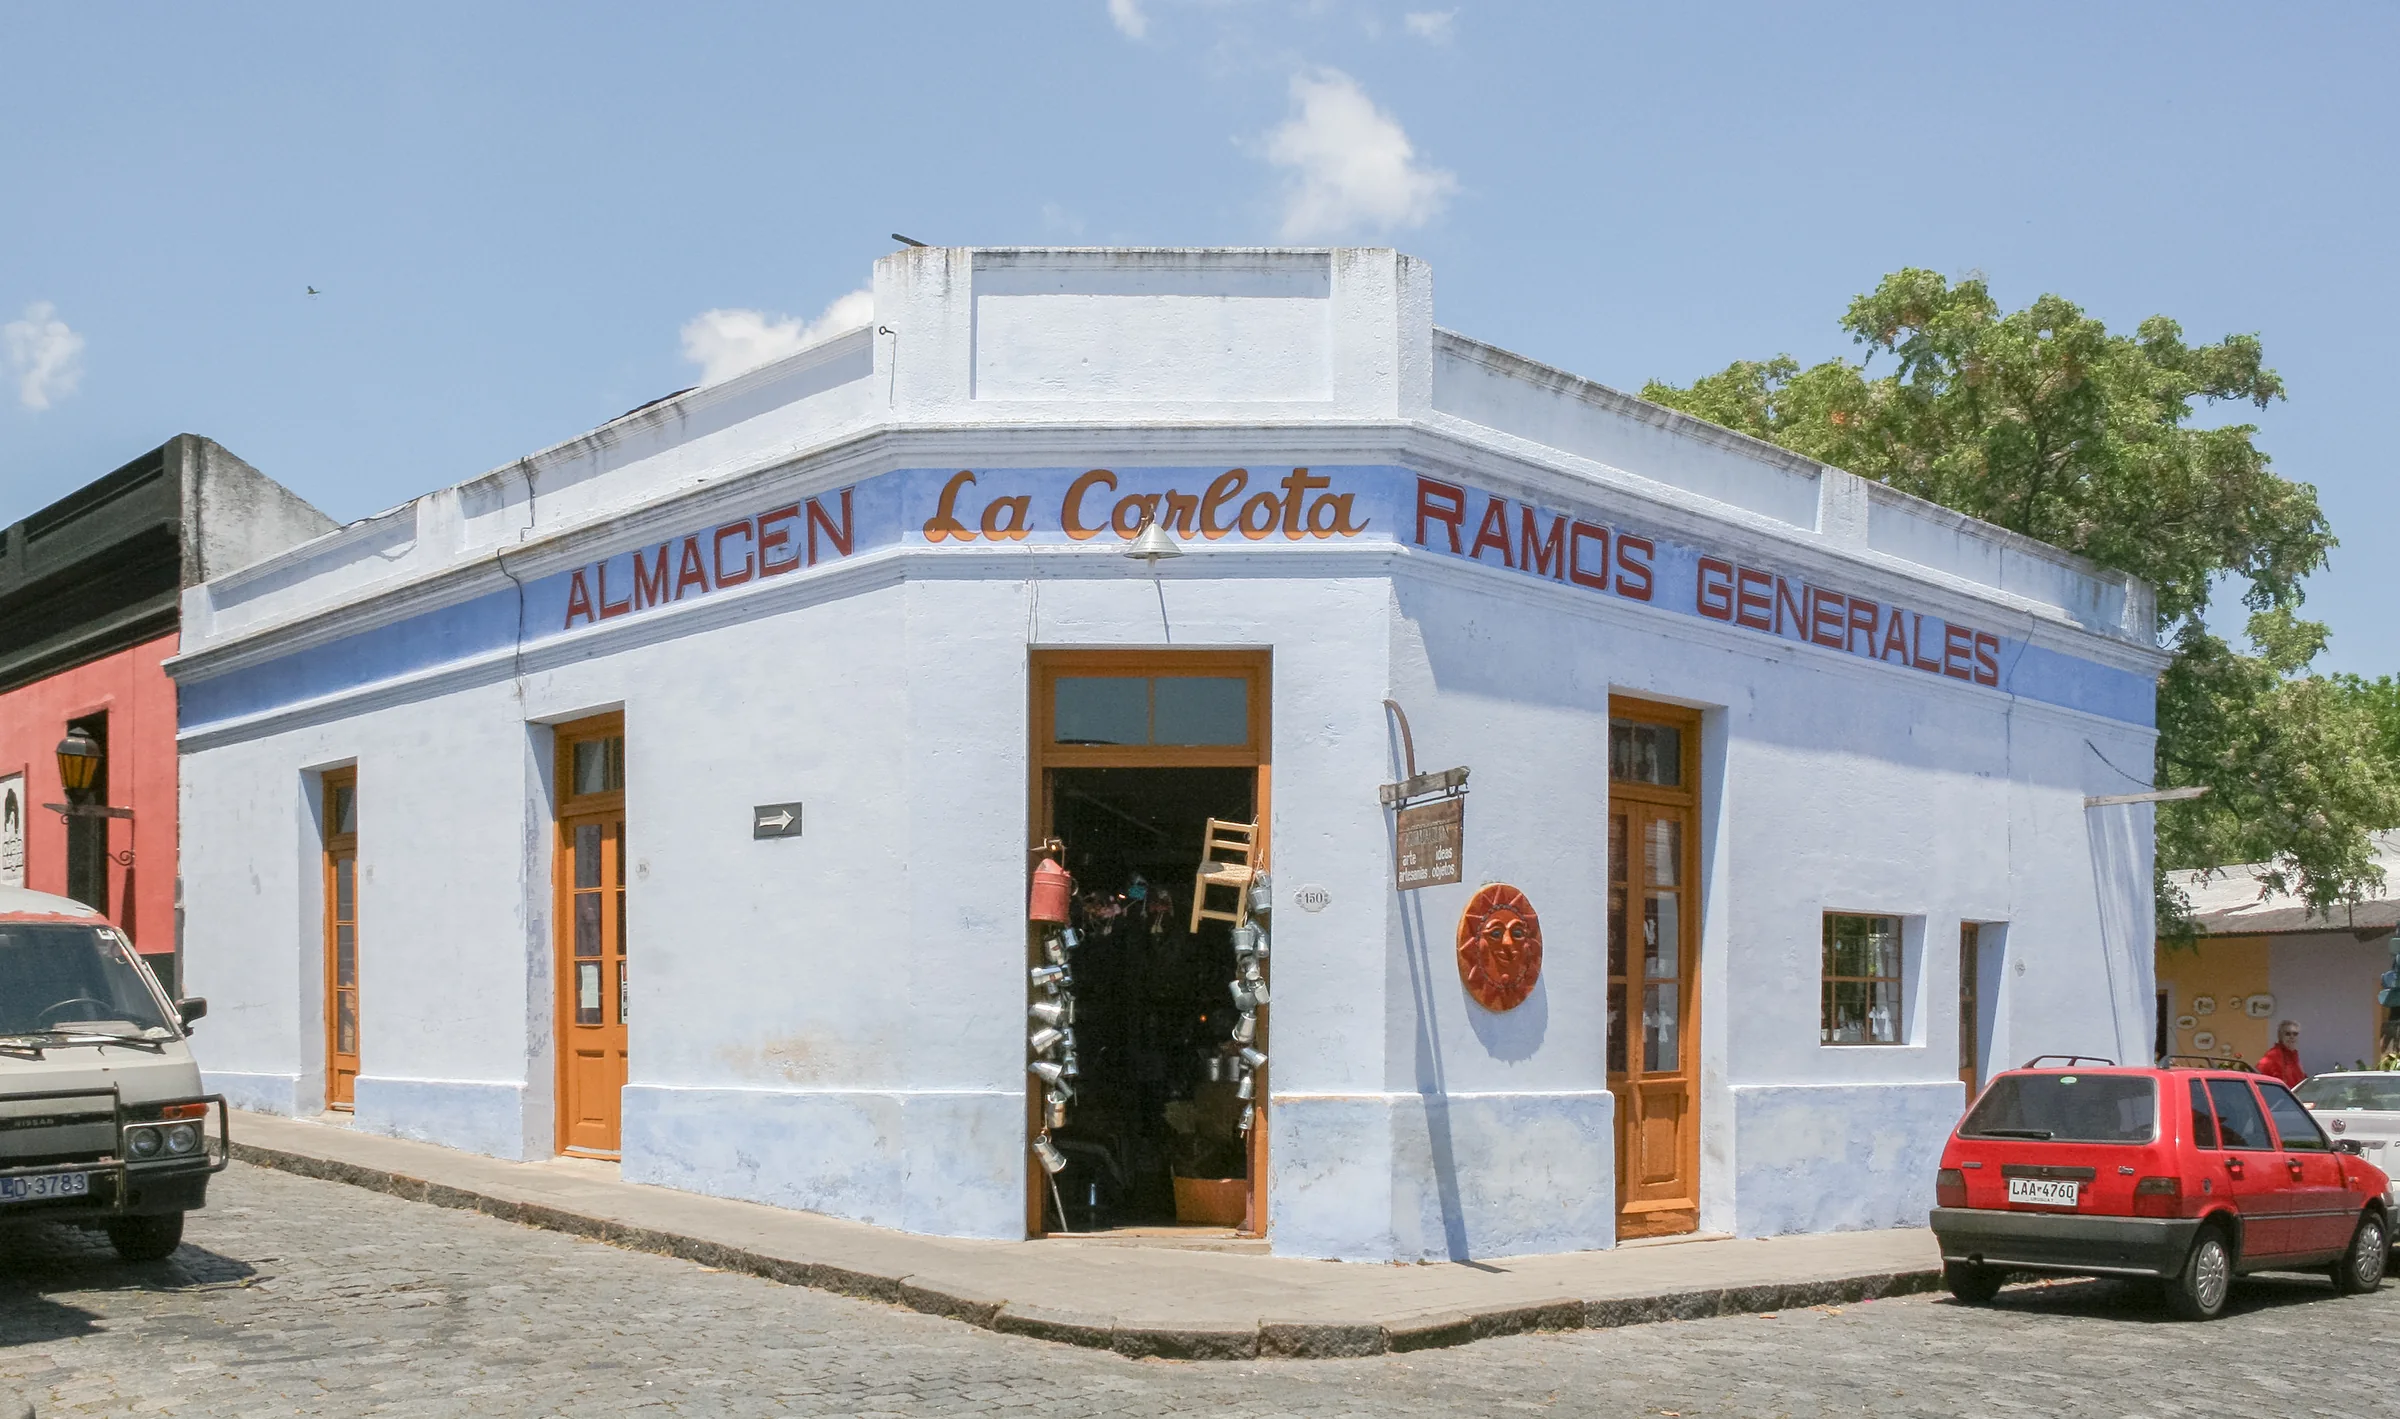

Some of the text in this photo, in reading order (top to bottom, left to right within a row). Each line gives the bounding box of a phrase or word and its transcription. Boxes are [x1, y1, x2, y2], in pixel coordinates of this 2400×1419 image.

[923, 467, 1370, 542] La Carlota
[564, 485, 856, 630] ALMACEN
[1415, 474, 1999, 688] RAMOS GENERALES
[1402, 844, 1453, 867] arte ideas
[1431, 861, 1455, 880] objetos
[1305, 892, 1323, 904] 150
